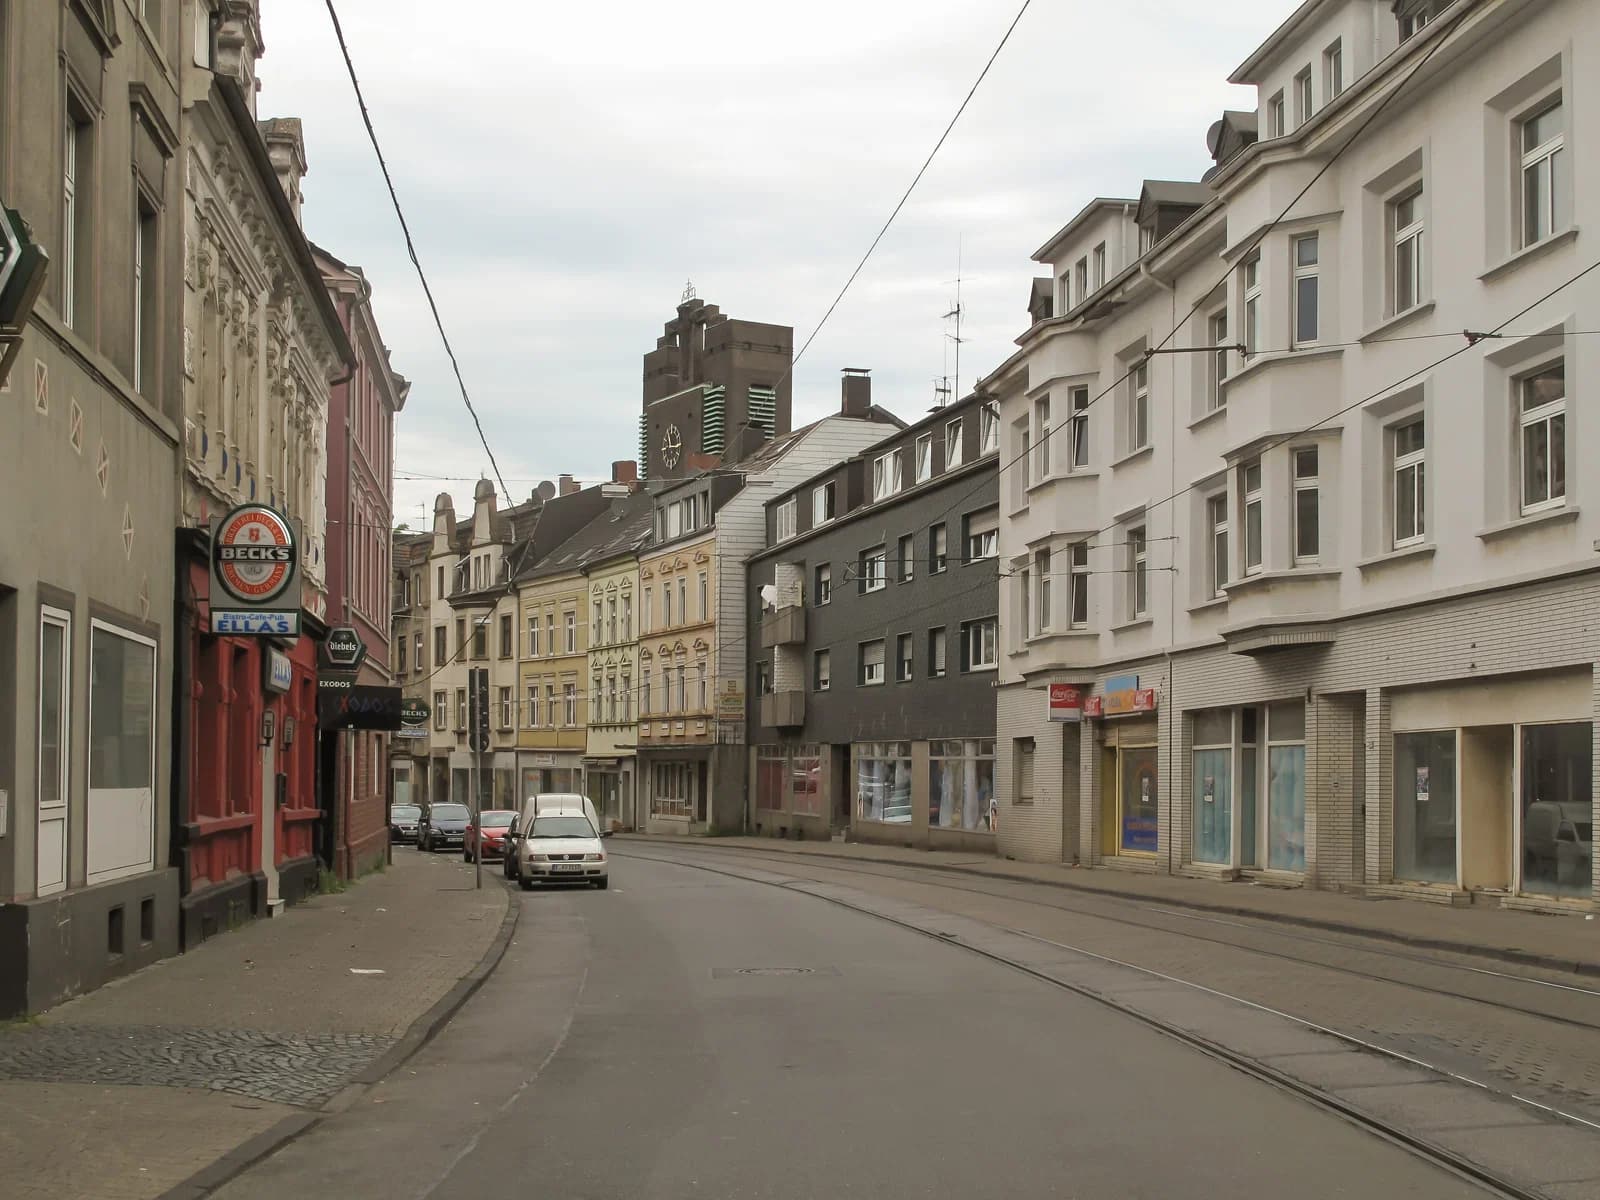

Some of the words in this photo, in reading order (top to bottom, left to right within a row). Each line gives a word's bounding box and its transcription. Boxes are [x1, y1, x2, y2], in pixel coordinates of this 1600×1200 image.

[221, 546, 290, 560] BECK'S
[217, 620, 289, 632] ELLAS
[319, 680, 351, 688] EXODOS
